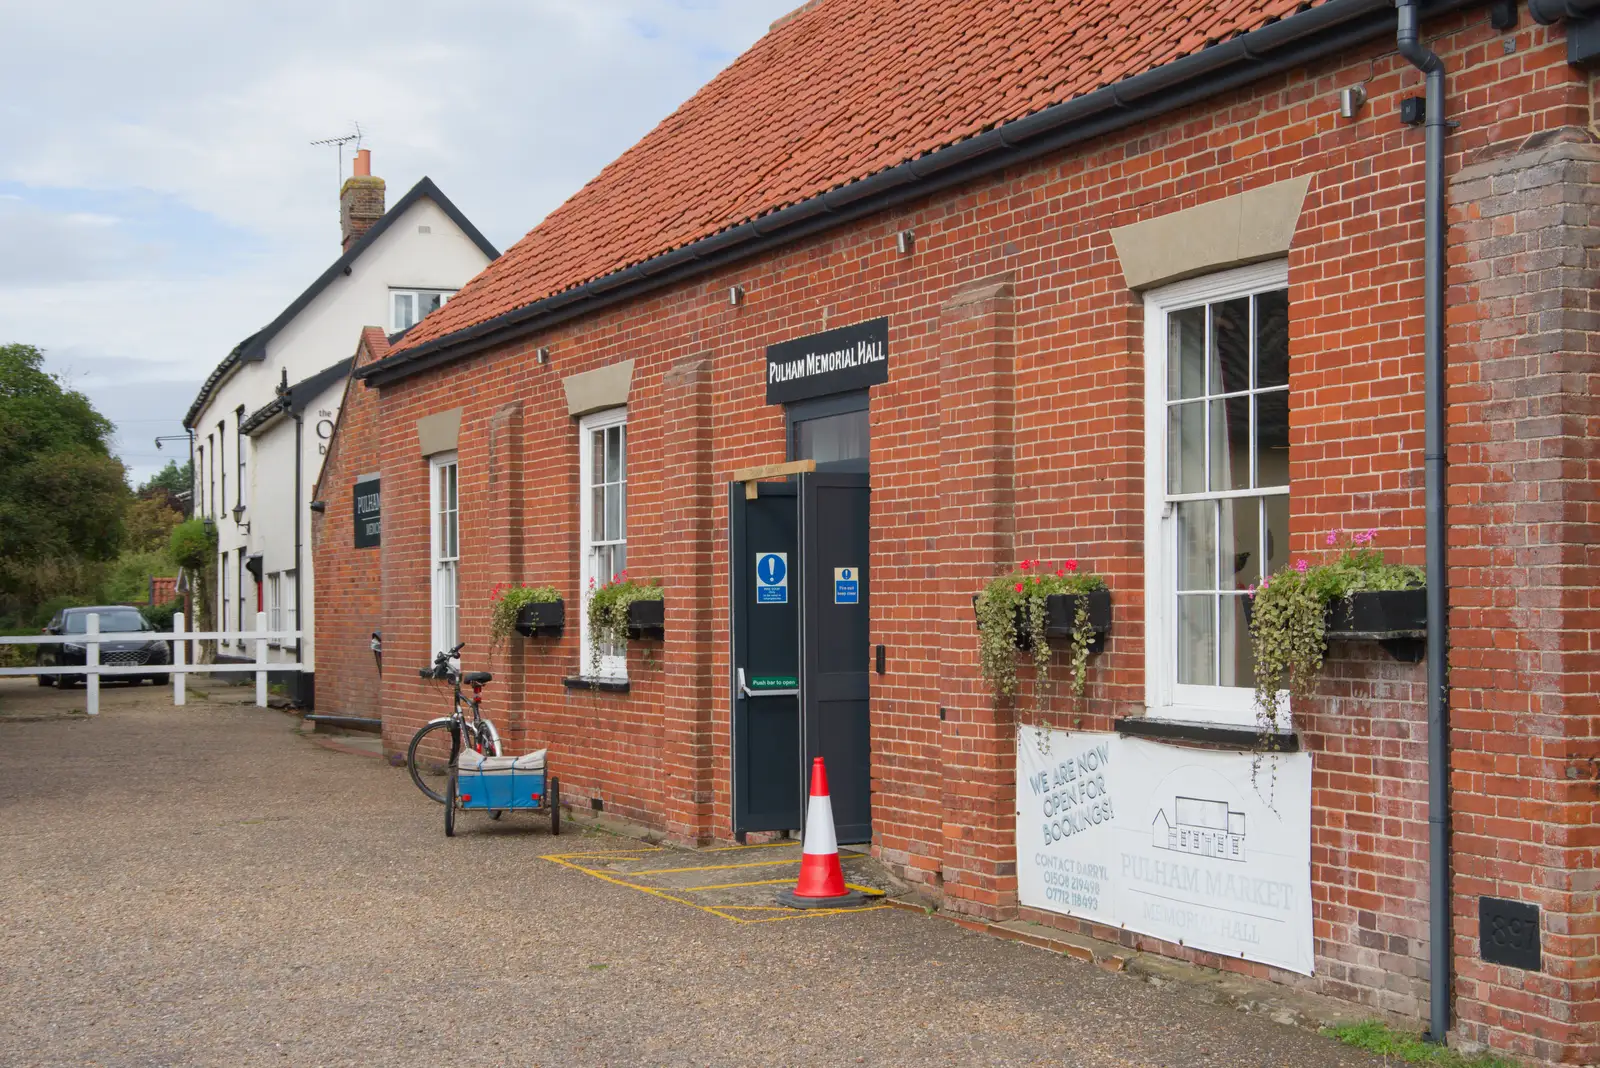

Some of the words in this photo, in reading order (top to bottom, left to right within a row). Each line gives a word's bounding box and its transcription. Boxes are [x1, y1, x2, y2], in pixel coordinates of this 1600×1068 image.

[769, 359, 804, 384] PULHAM
[806, 347, 857, 376] MEMORIAL
[858, 341, 885, 364] HALL
[318, 408, 332, 417] the
[1030, 770, 1050, 796] WE
[1053, 758, 1076, 788] ARE
[1076, 741, 1108, 777] NOW
[1043, 784, 1077, 817] OPEN
[1078, 772, 1106, 804] FOR
[1042, 796, 1114, 846] BOOKINGS!
[1035, 852, 1075, 872] CONTACT
[1044, 870, 1070, 888] 01508
[1120, 853, 1200, 893] PULHAM
[1206, 870, 1293, 910] MARKET
[1046, 886, 1070, 904] 07712
[1143, 901, 1218, 934] MEMOR
[1220, 918, 1260, 944] HALL
